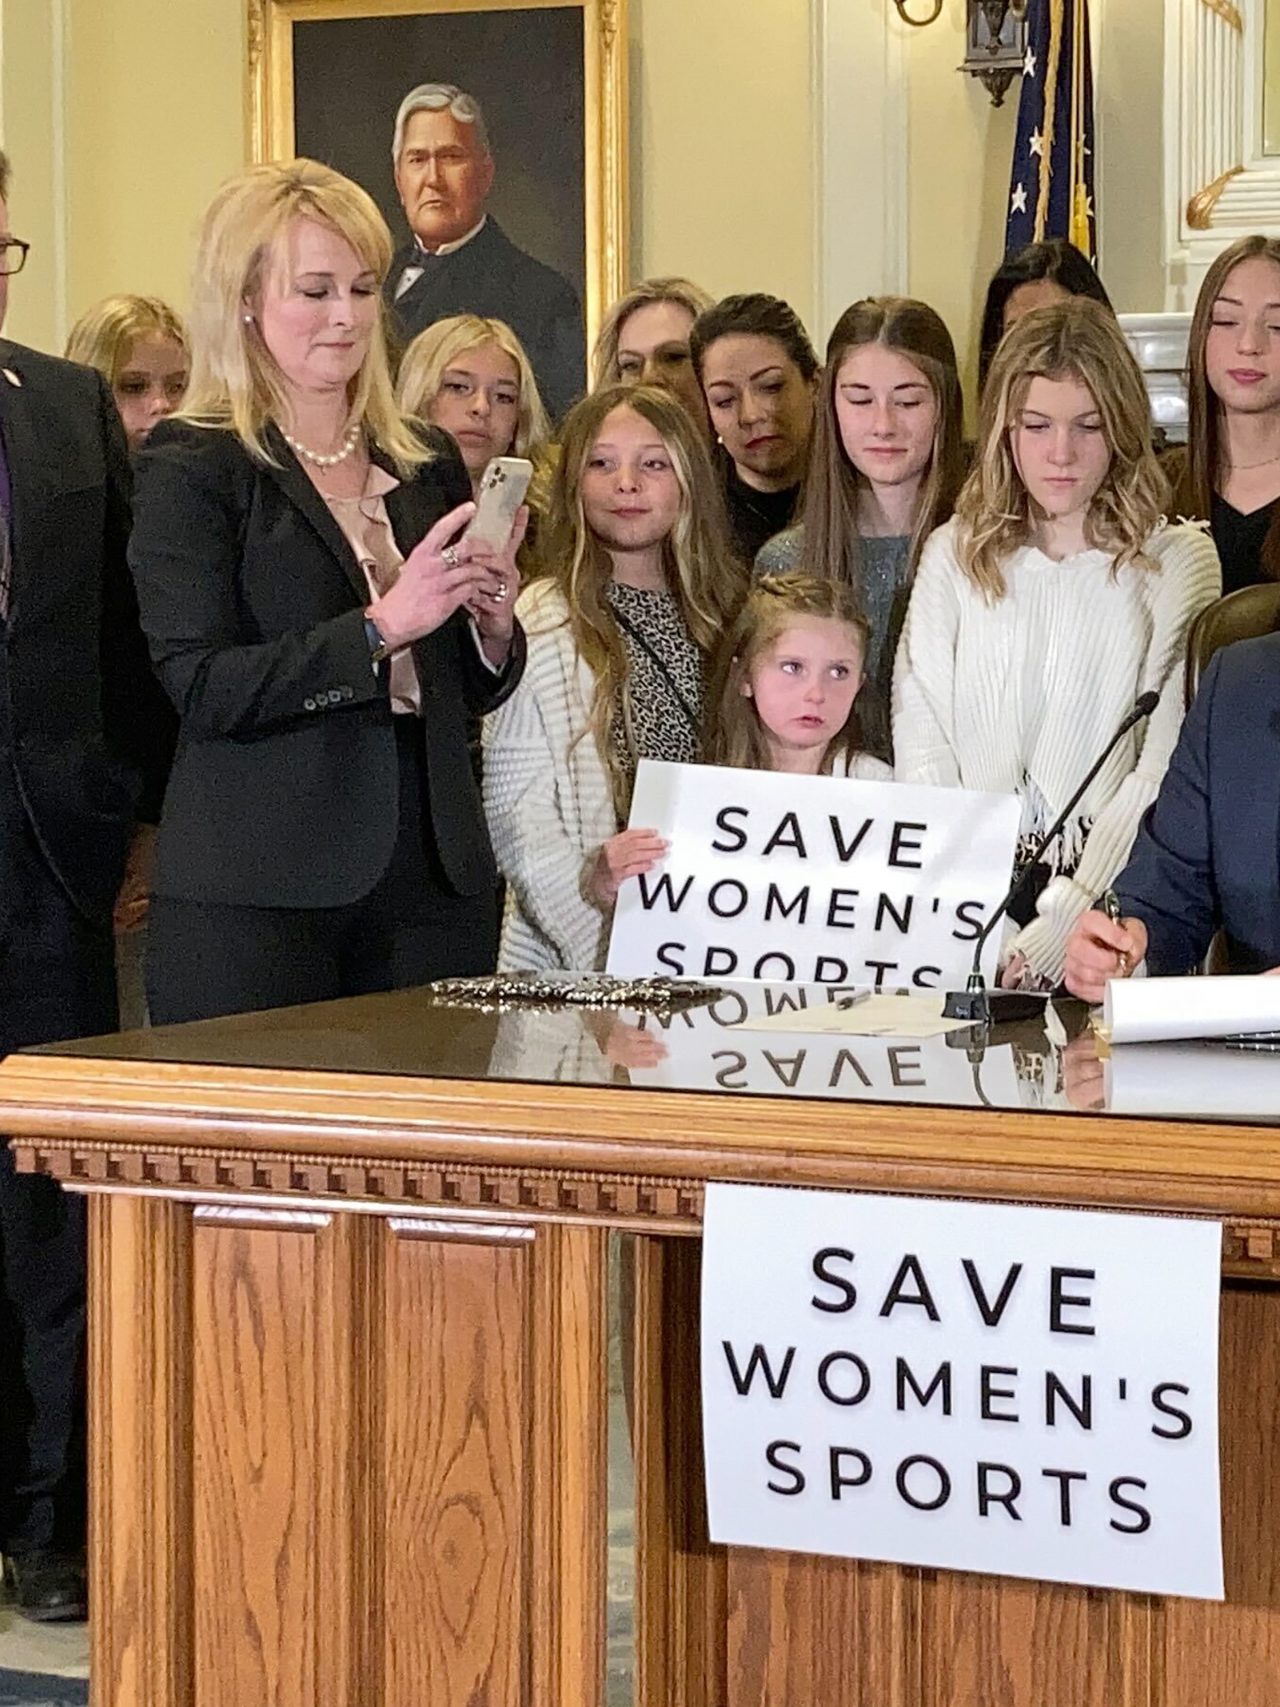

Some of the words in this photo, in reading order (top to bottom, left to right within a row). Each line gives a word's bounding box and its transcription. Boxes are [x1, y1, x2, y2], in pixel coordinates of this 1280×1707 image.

[711, 806, 927, 869] SAVE
[637, 873, 986, 941] WOMEN'S
[811, 1247, 1096, 1337] SAVE
[721, 1340, 1193, 1440] WOMEN'S
[765, 1440, 1151, 1534] SPORTS
